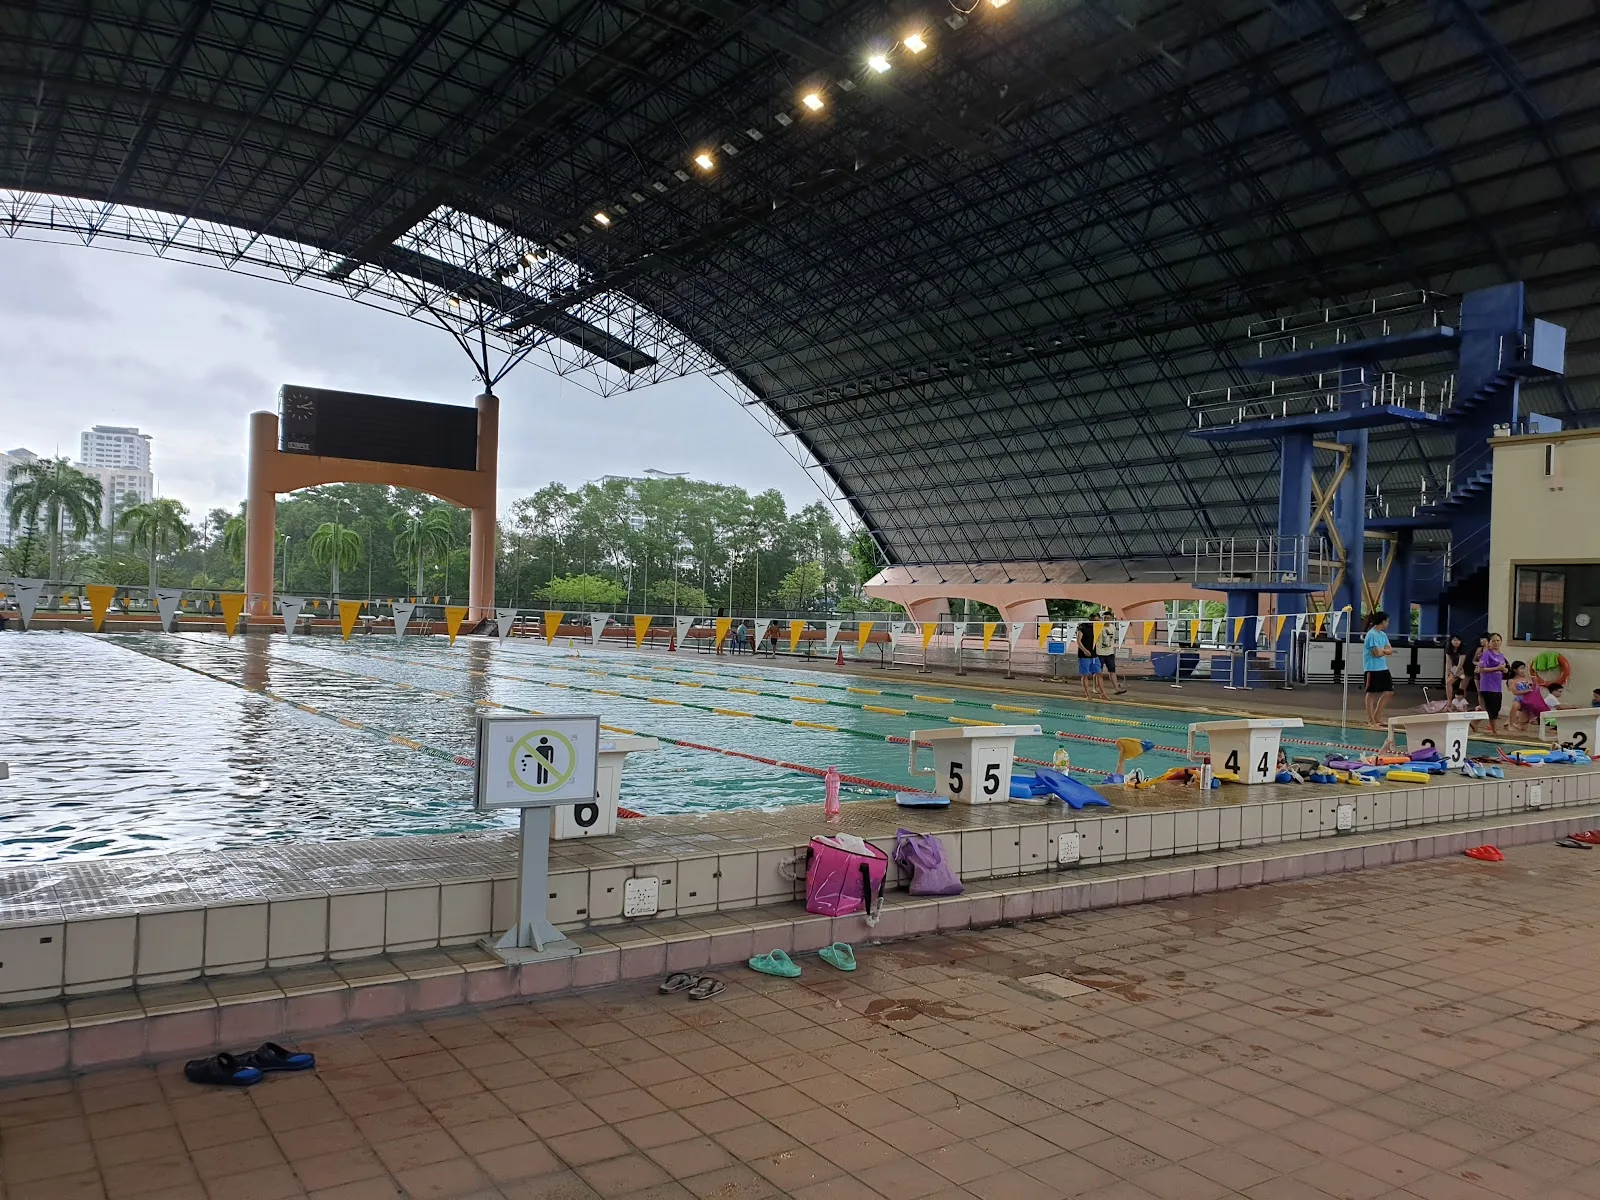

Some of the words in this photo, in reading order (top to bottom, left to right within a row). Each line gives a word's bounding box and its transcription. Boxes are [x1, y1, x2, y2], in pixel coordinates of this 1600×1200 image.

[1451, 739, 1461, 763] 3
[1572, 731, 1588, 752] 2
[1224, 749, 1241, 775] 4
[1257, 751, 1269, 778] 4
[948, 761, 964, 794] 5
[983, 763, 1001, 795] 5
